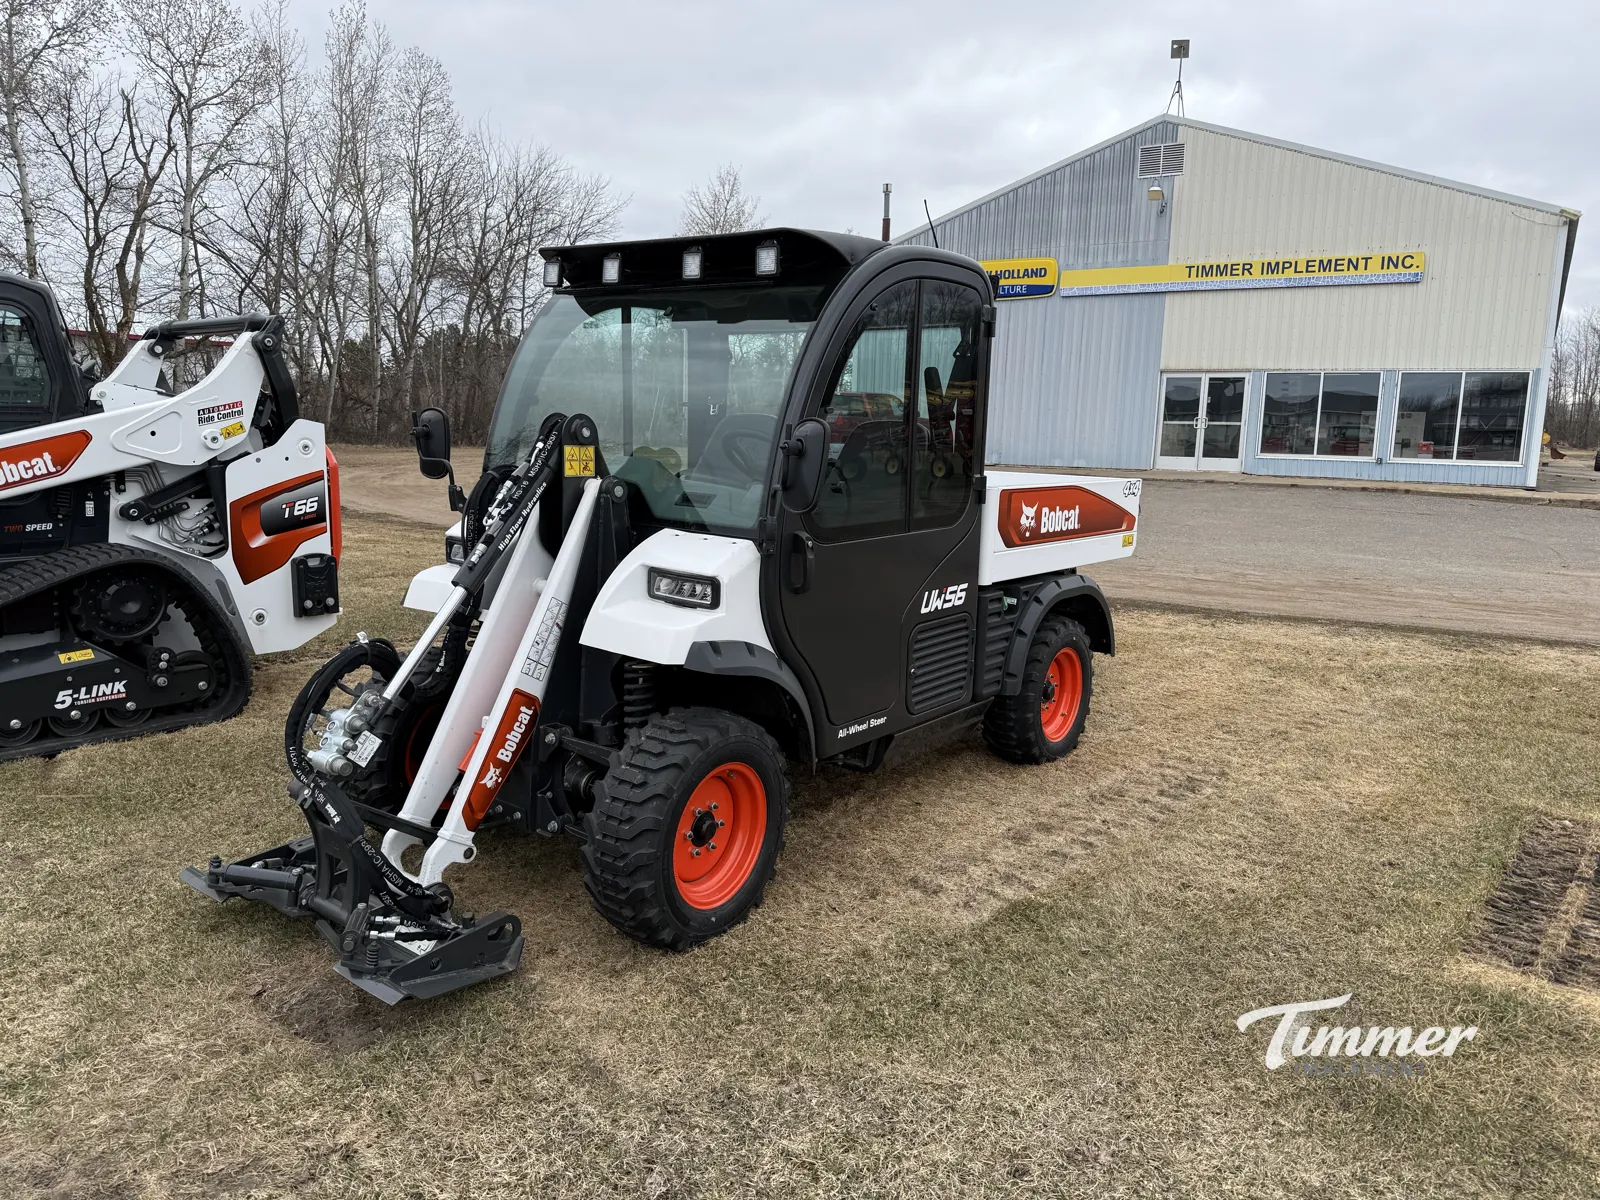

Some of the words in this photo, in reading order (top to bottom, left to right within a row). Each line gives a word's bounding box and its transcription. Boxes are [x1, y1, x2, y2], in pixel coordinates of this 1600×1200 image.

[1185, 262, 1253, 279] TIMMER
[1260, 256, 1373, 276] IMPLEMENT
[1380, 254, 1421, 271] INC.
[198, 414, 215, 425] Ride
[217, 408, 244, 421] Control
[199, 401, 242, 416] AUTOMATIC
[0, 451, 56, 486] bcat
[1123, 480, 1141, 498] 4x4
[282, 496, 319, 518] T66
[498, 533, 511, 551] High
[510, 518, 523, 533] Flow
[521, 482, 547, 516] Hydraulics
[25, 522, 53, 532] SPEED
[1040, 505, 1080, 533] Bobcat
[53, 680, 128, 710] 5-LINK
[74, 698, 95, 706] TORSION
[96, 692, 127, 702] SUSPENSION
[496, 705, 534, 763] Bobcat
[837, 721, 869, 739] All-Wheel
[869, 716, 888, 728] Steer
[382, 865, 404, 887] MSHA
